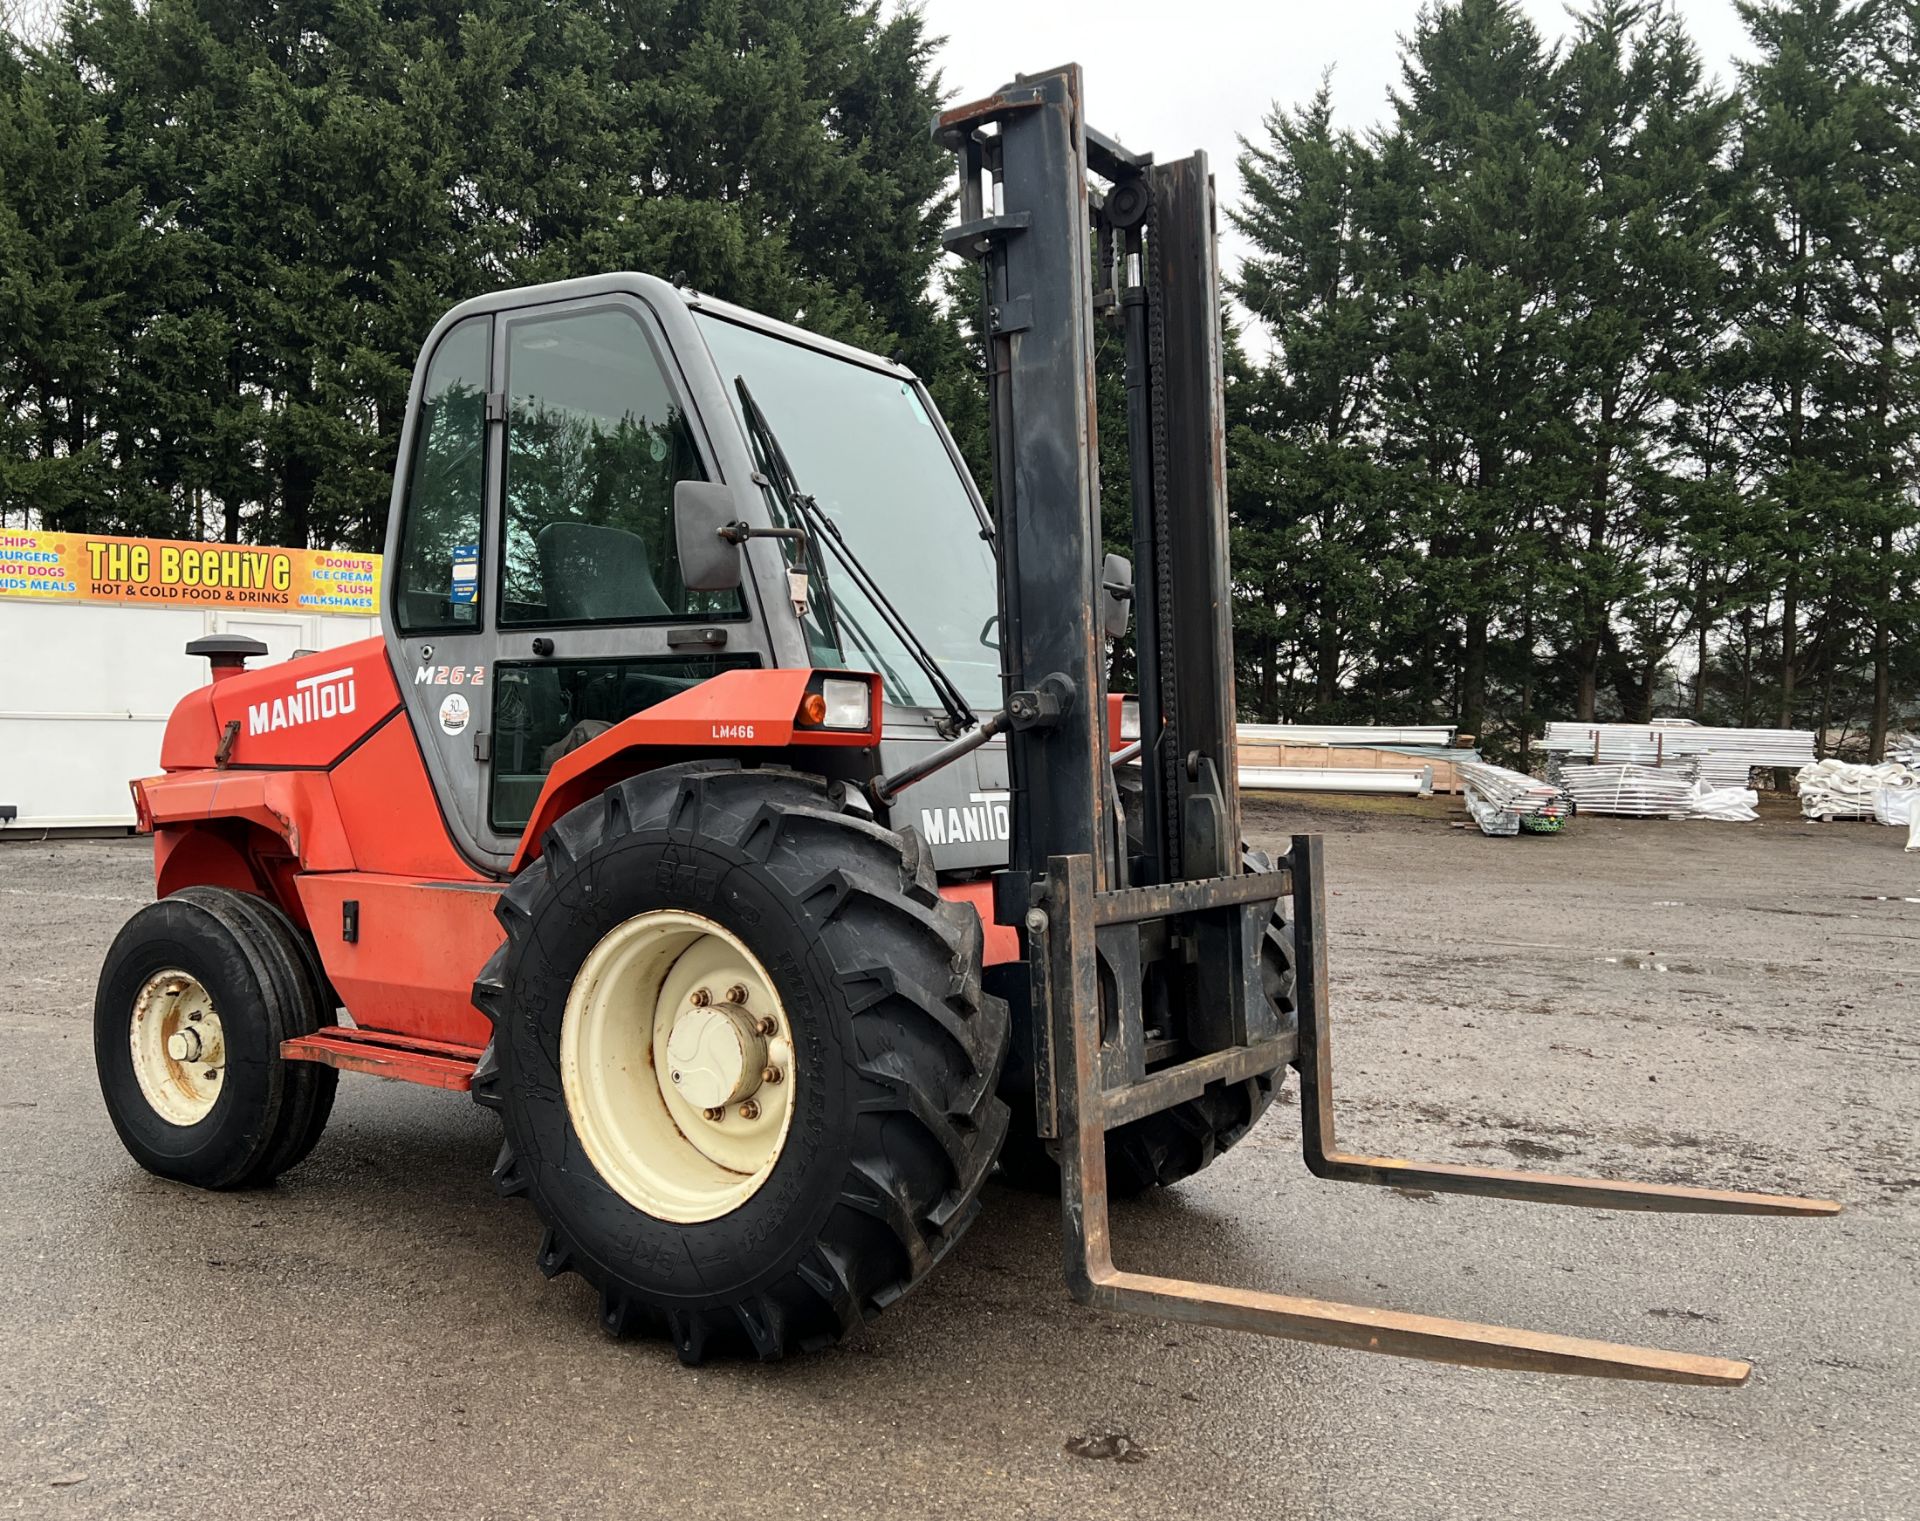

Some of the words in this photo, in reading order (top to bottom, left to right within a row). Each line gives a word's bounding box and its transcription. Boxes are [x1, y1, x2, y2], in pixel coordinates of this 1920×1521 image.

[326, 558, 373, 570] DONUTS
[28, 566, 65, 577] DOGS
[312, 570, 330, 580] ICE
[333, 571, 373, 582] CREAM
[31, 580, 76, 592] MEALS
[337, 584, 373, 595] SLUSH
[92, 583, 121, 595] HOT
[126, 584, 136, 596] &
[140, 585, 178, 598] COLD
[182, 588, 221, 600] FOOD
[225, 590, 235, 601] &
[239, 591, 289, 604] DRINKS
[300, 595, 372, 607] MILKSHAKES
[414, 666, 485, 685] M26-2
[248, 667, 355, 736] MANITOU
[712, 725, 754, 739] LM466
[922, 792, 1010, 845] MANITO
